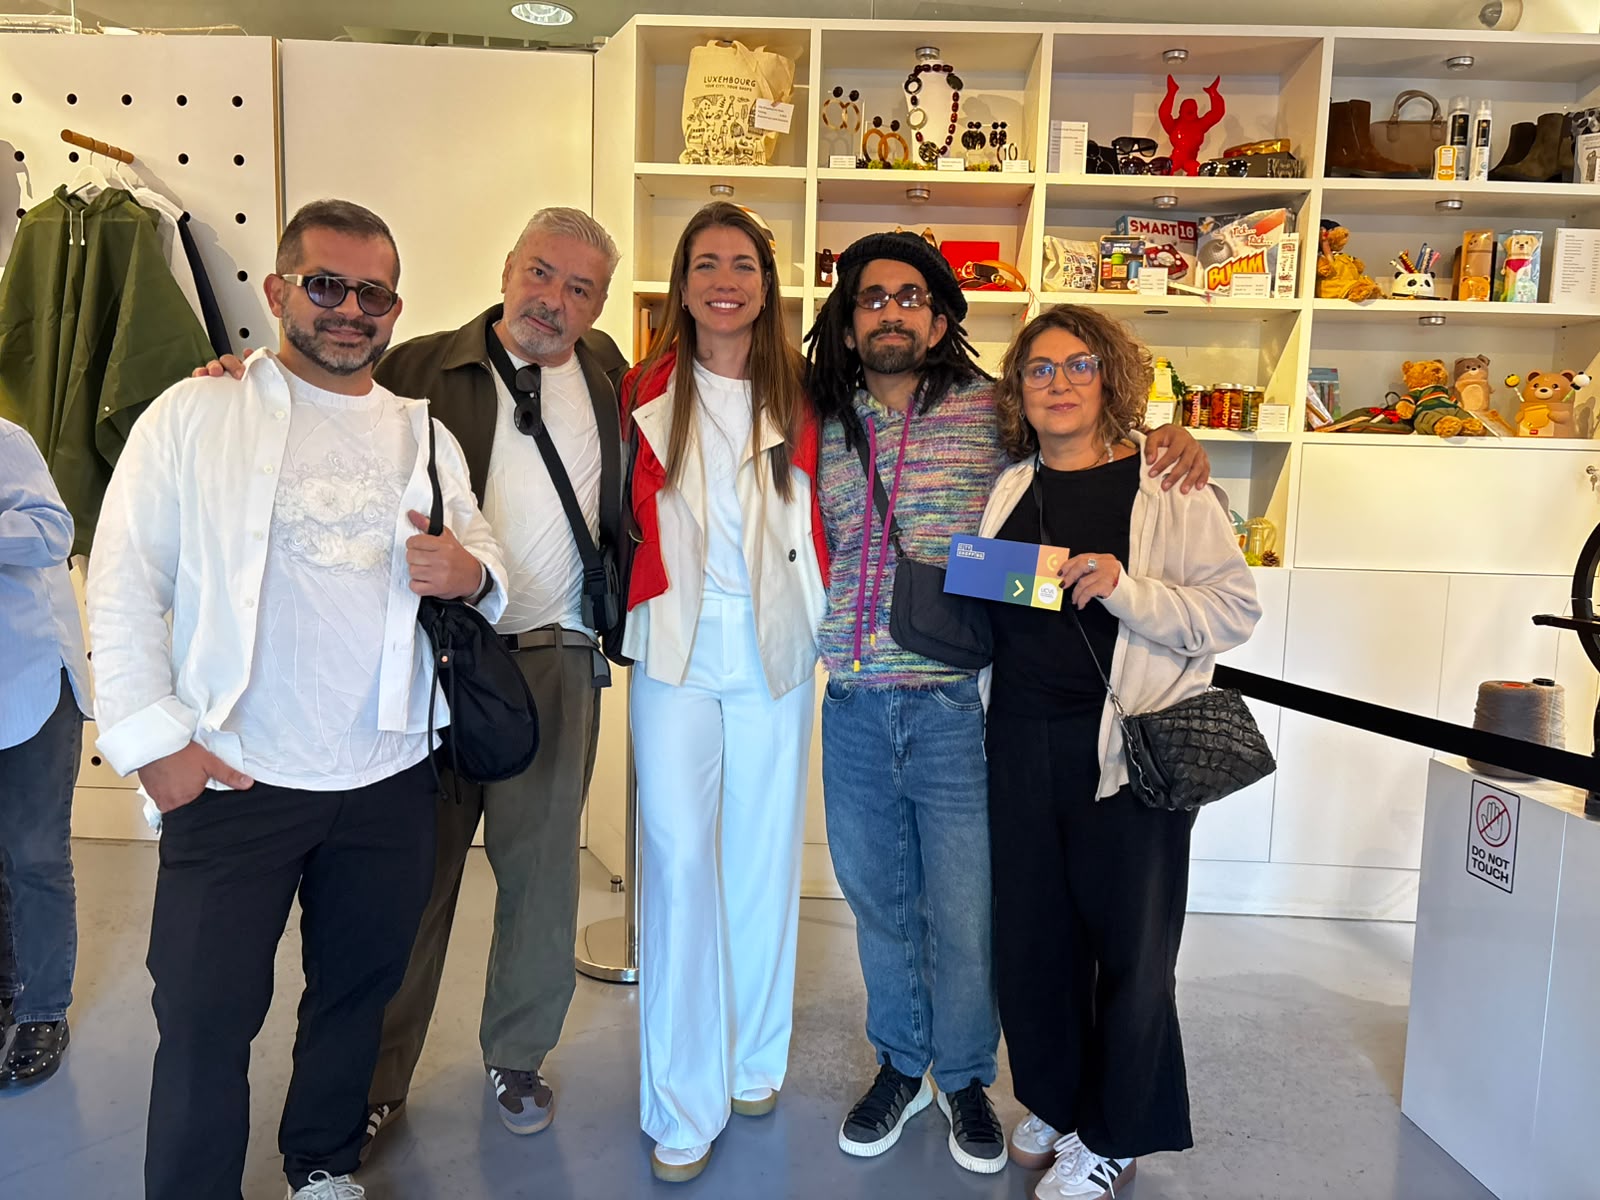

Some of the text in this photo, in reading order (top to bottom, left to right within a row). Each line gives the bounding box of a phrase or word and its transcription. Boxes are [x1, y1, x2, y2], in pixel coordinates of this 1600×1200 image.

[703, 75, 756, 88] LUXEMBOURG
[1130, 220, 1177, 236] SMART
[1180, 225, 1194, 239] 10
[1207, 250, 1266, 291] BUMM
[1471, 845, 1510, 870] DO NOT
[1471, 857, 1509, 884] TOUCH
